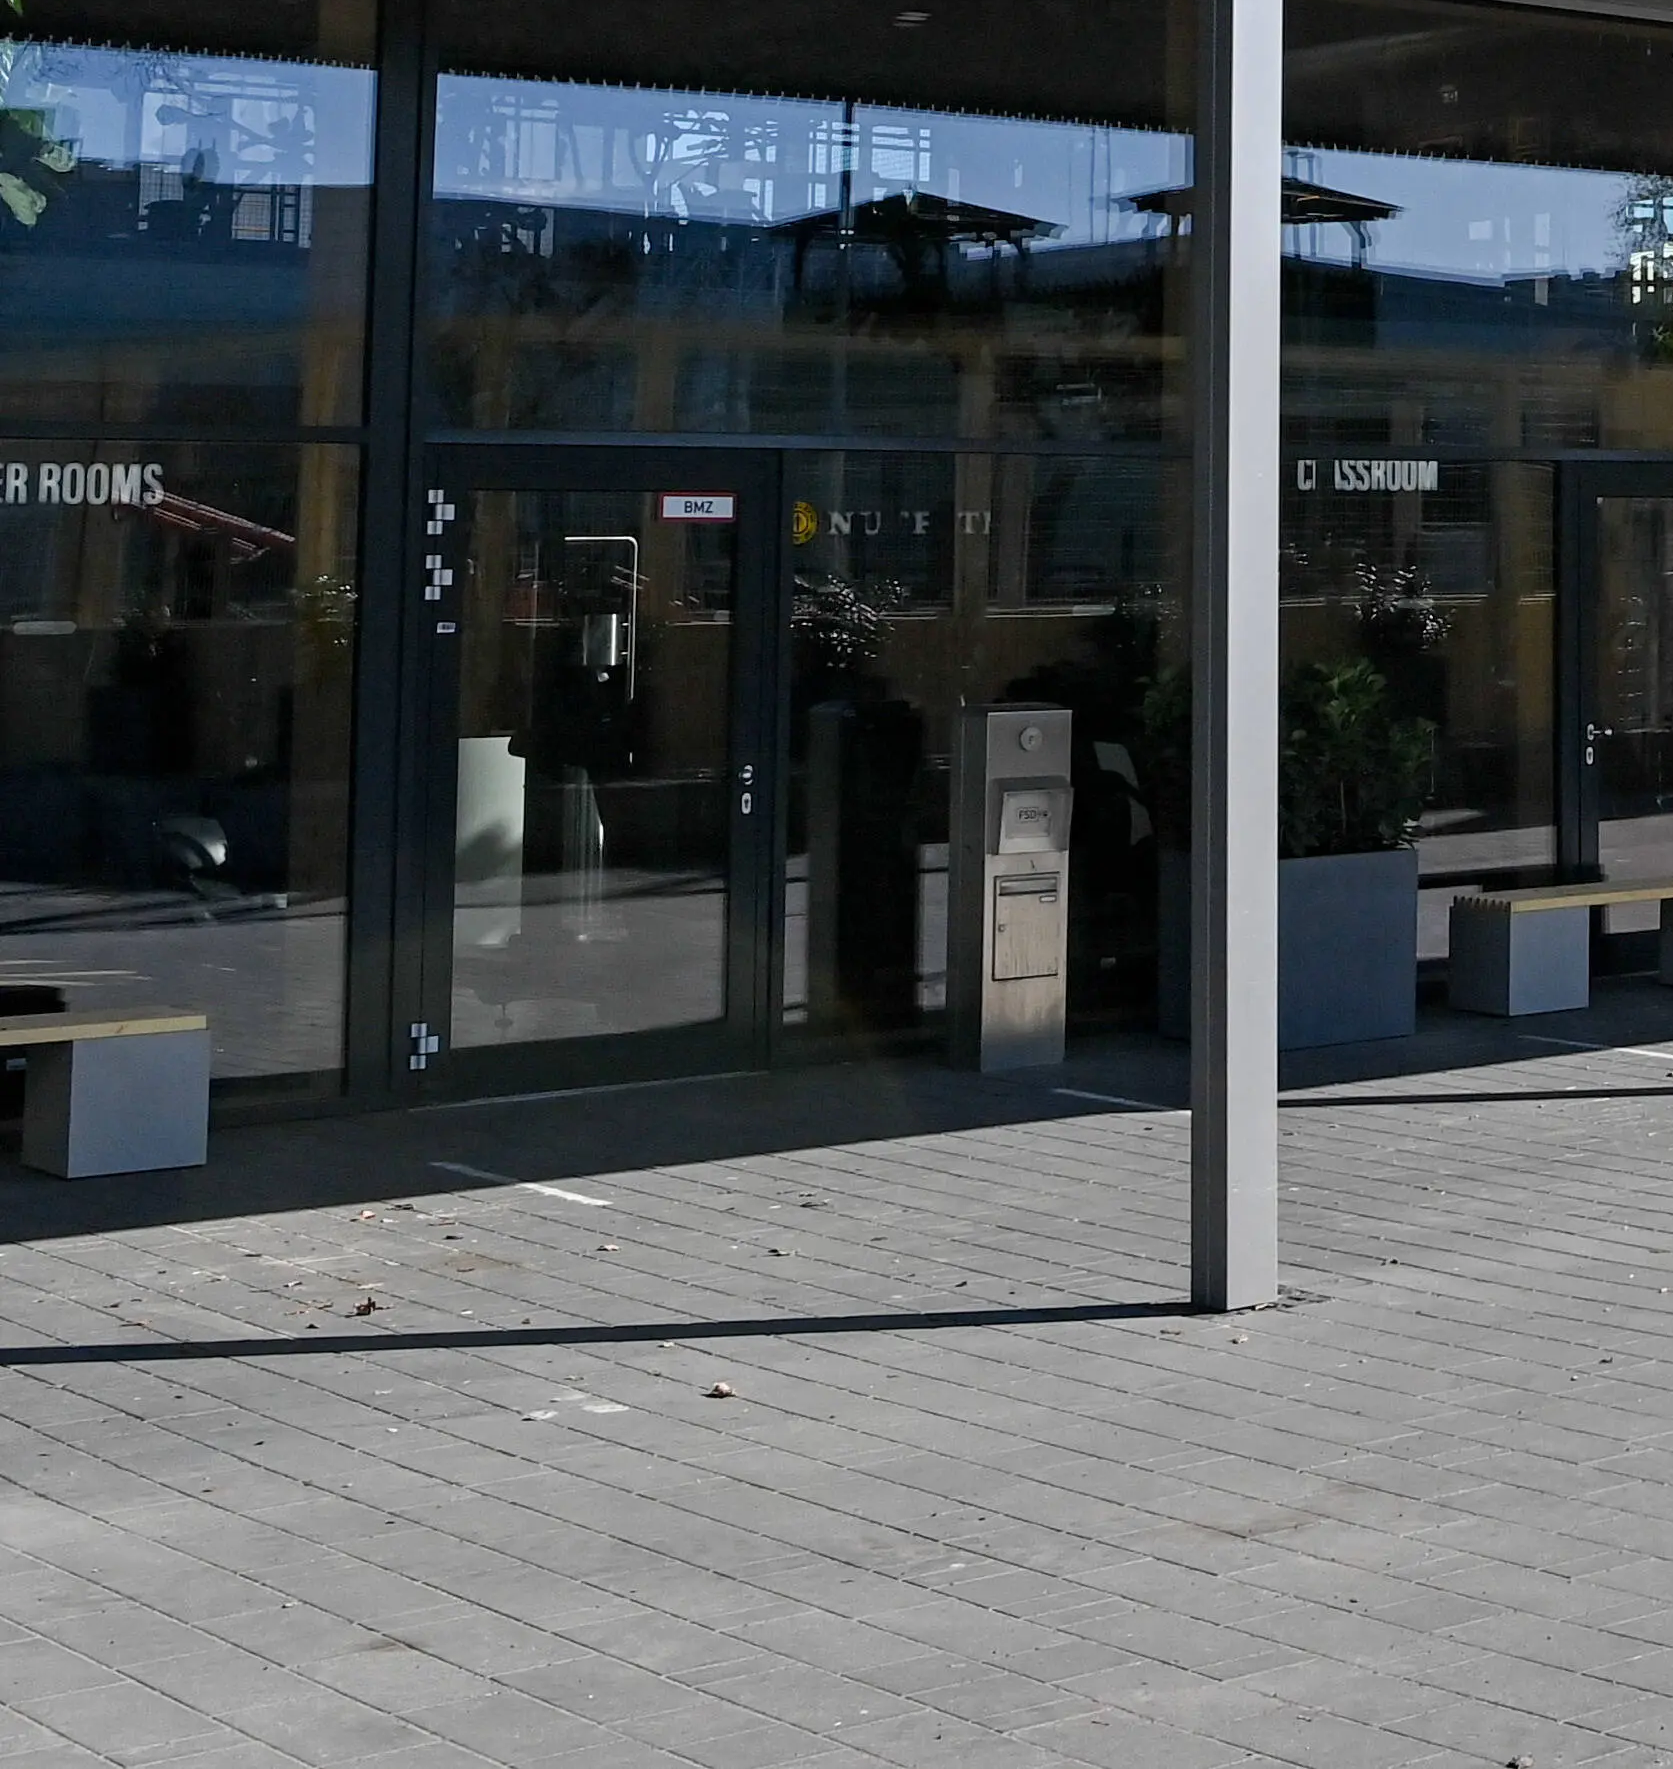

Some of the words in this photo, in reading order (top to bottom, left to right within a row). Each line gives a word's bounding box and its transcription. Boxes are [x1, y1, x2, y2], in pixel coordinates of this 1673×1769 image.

[0, 462, 29, 505] R
[38, 461, 165, 506] ROOMS
[683, 500, 713, 514] BMZ
